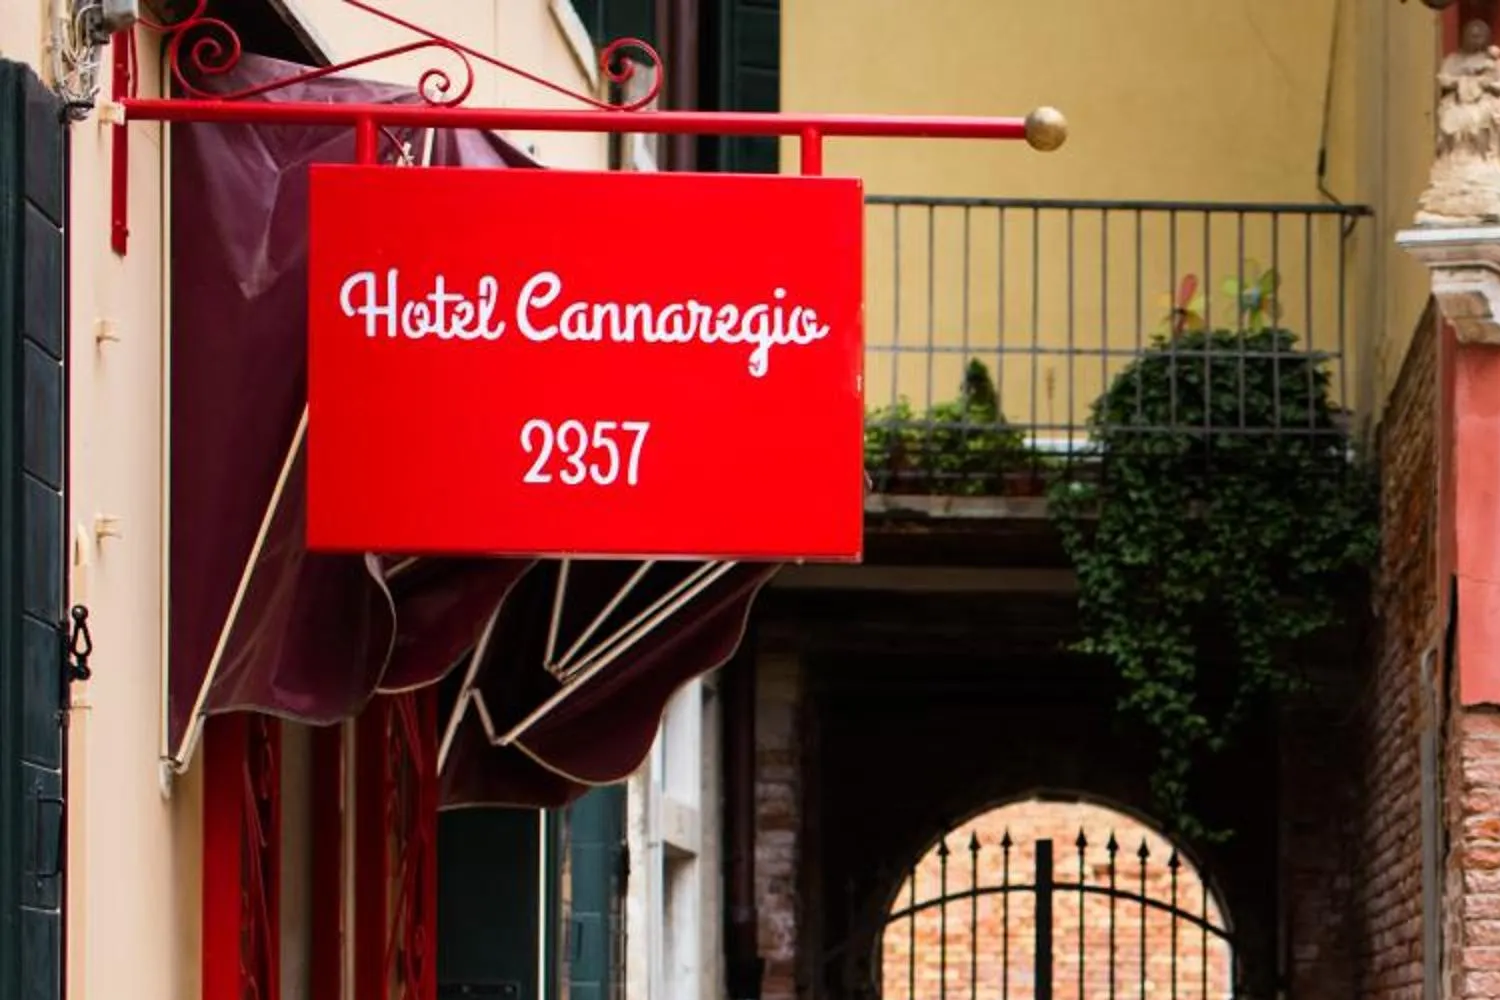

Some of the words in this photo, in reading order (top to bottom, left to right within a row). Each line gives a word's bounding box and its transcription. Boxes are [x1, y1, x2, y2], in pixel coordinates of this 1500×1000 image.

[340, 268, 505, 340] Hotel
[517, 271, 829, 378] Cannaregio
[520, 419, 650, 486] 2357
